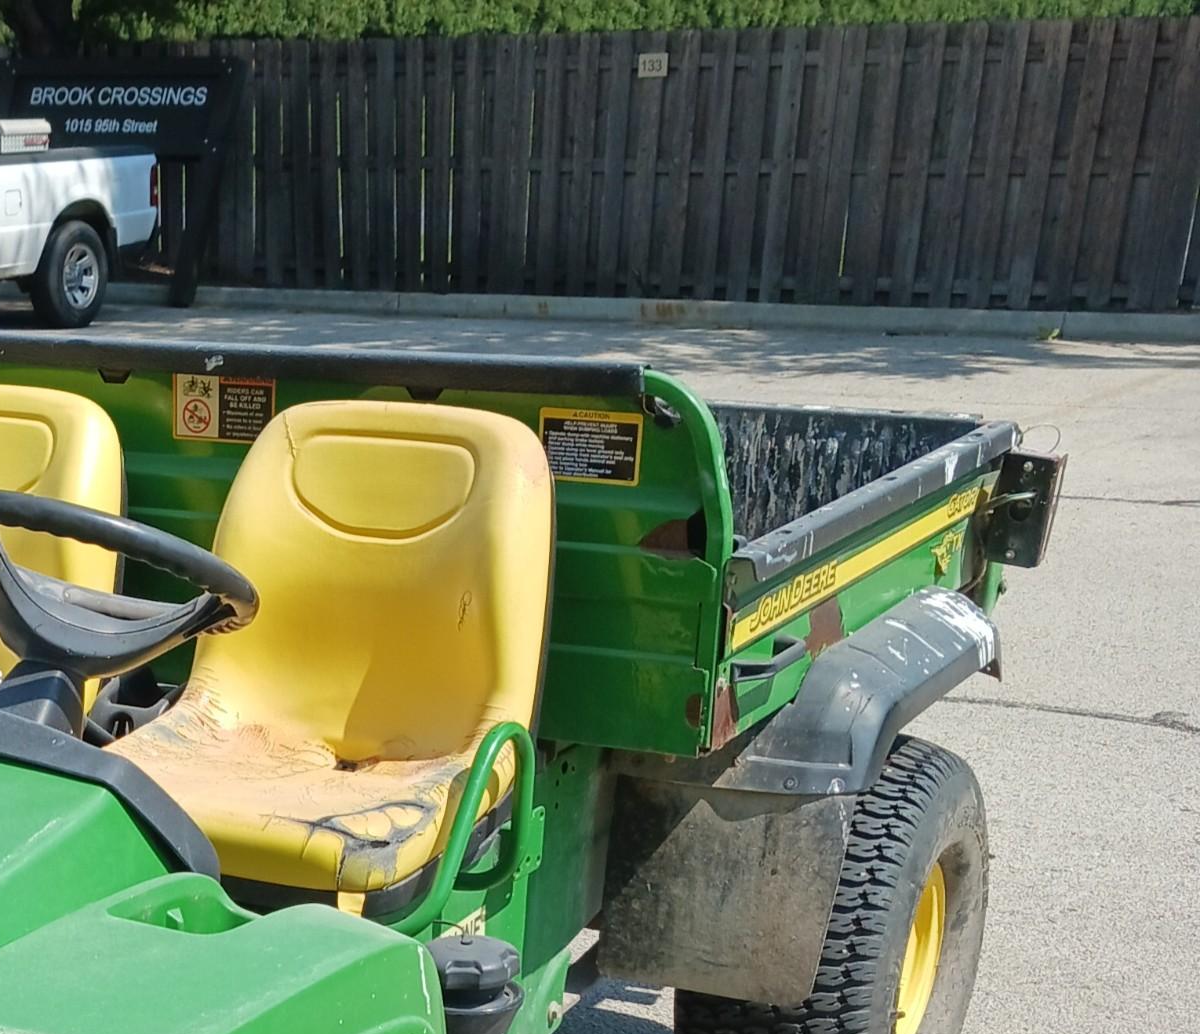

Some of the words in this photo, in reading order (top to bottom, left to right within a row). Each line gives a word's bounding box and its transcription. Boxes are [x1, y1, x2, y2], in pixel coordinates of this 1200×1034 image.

[30, 86, 95, 105] BROOK
[98, 86, 207, 106] CROSSINGS
[65, 117, 92, 133] 1015
[94, 118, 120, 133] 95th
[122, 118, 158, 134] Street
[578, 411, 610, 420] CAUTION
[749, 582, 792, 632] JOHN
[790, 559, 839, 610] DEERE
